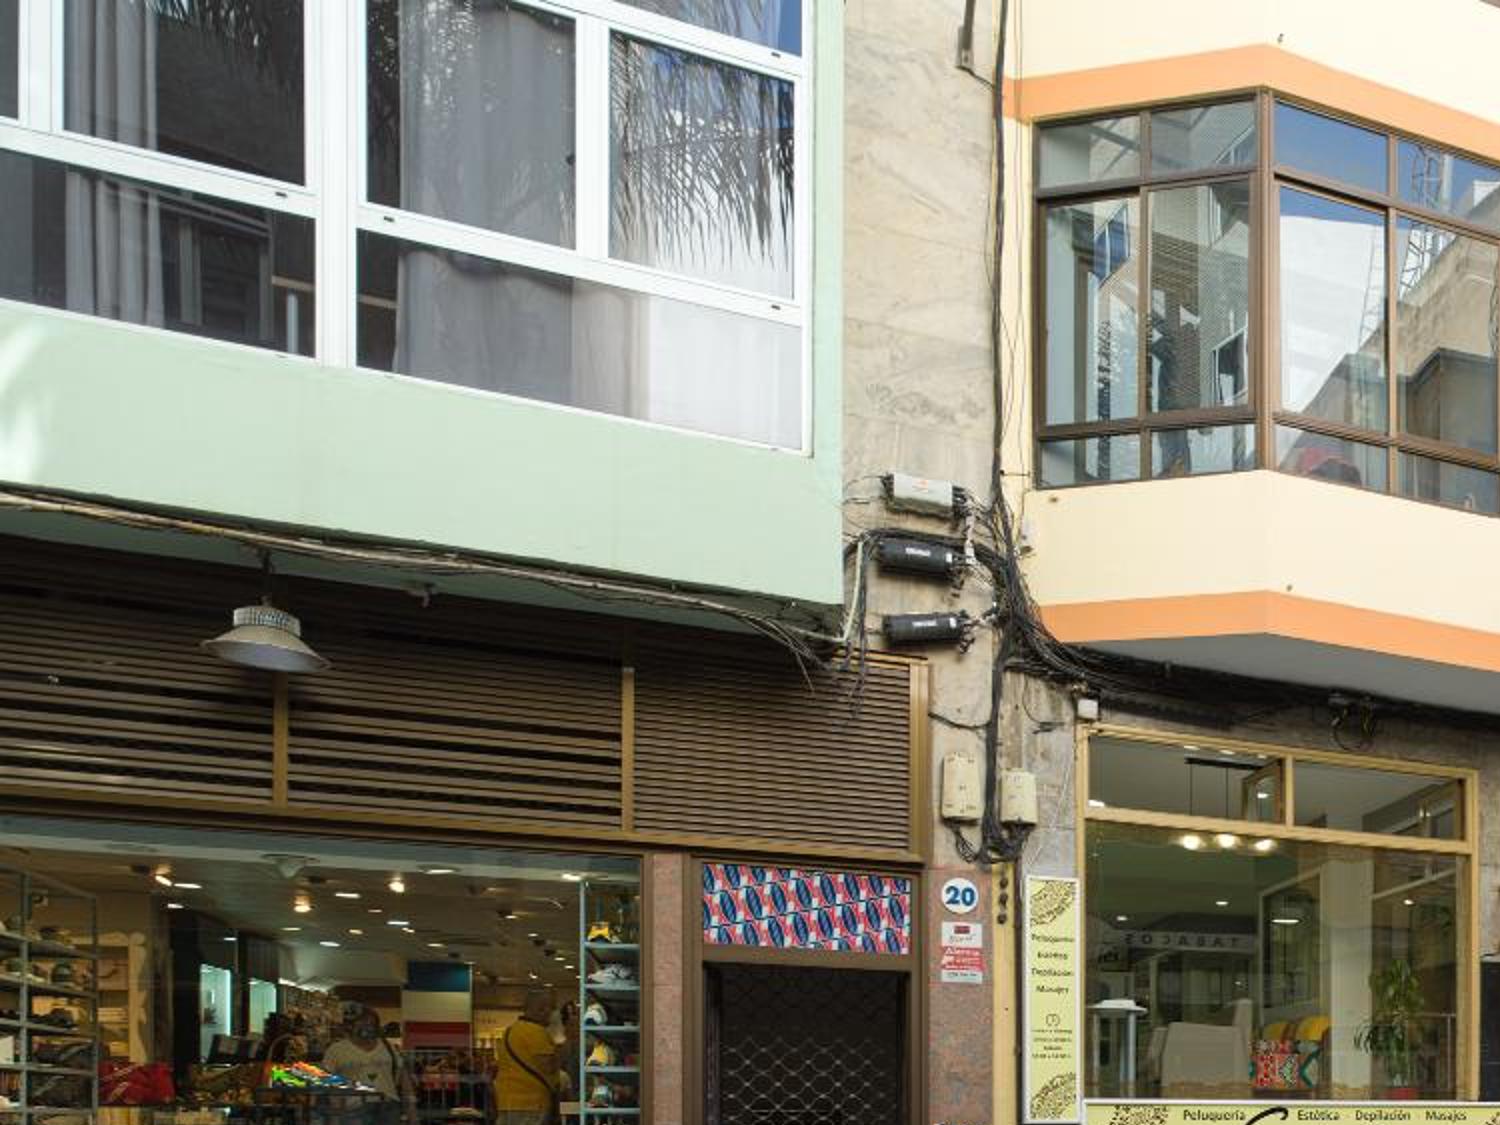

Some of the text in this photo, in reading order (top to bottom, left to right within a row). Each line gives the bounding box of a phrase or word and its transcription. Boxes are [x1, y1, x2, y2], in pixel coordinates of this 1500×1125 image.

[945, 885, 976, 907] 20
[1183, 1109, 1467, 1124] Peluquería Estética Depilación Masajes
